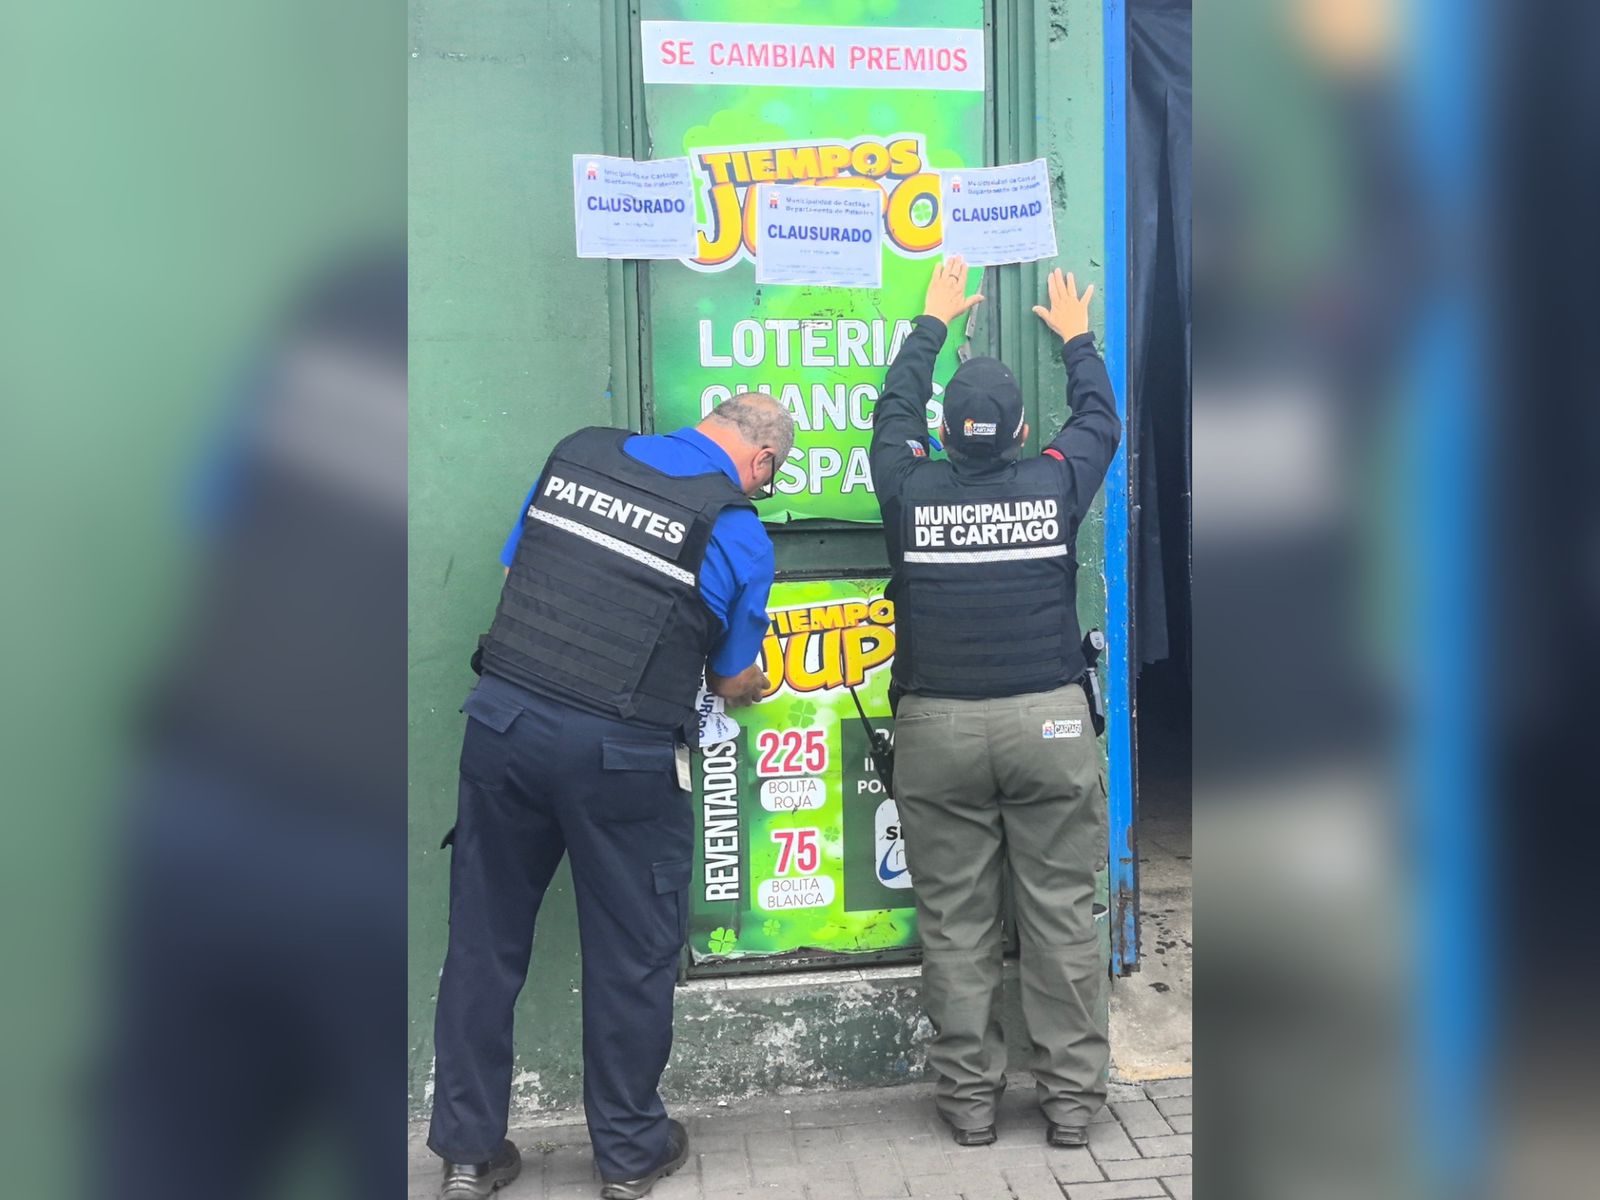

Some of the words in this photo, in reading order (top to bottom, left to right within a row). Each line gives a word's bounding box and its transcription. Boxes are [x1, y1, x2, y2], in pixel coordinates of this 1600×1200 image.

[660, 40, 694, 66] SE
[709, 42, 836, 69] CAMBIAN
[850, 45, 968, 72] PREMIOS
[699, 139, 921, 186] TIEMPOS
[587, 196, 685, 213] CLAUSURADO
[690, 173, 943, 266] JO
[768, 224, 872, 243] CLAUSURADO
[543, 475, 686, 544] PATENTES
[915, 500, 1058, 525] MUNICIPALIDAD
[915, 526, 945, 547] DE
[950, 520, 1058, 545] CARTAGO
[761, 625, 896, 697] JUP
[759, 730, 826, 773] 225
[769, 780, 817, 794] BOLITA
[857, 779, 887, 794] PO
[774, 796, 813, 809] ROJA
[703, 740, 740, 900] REVENTADOS
[774, 831, 817, 872] 75
[772, 878, 819, 893] BOLITA
[768, 894, 825, 908] BLANCA
